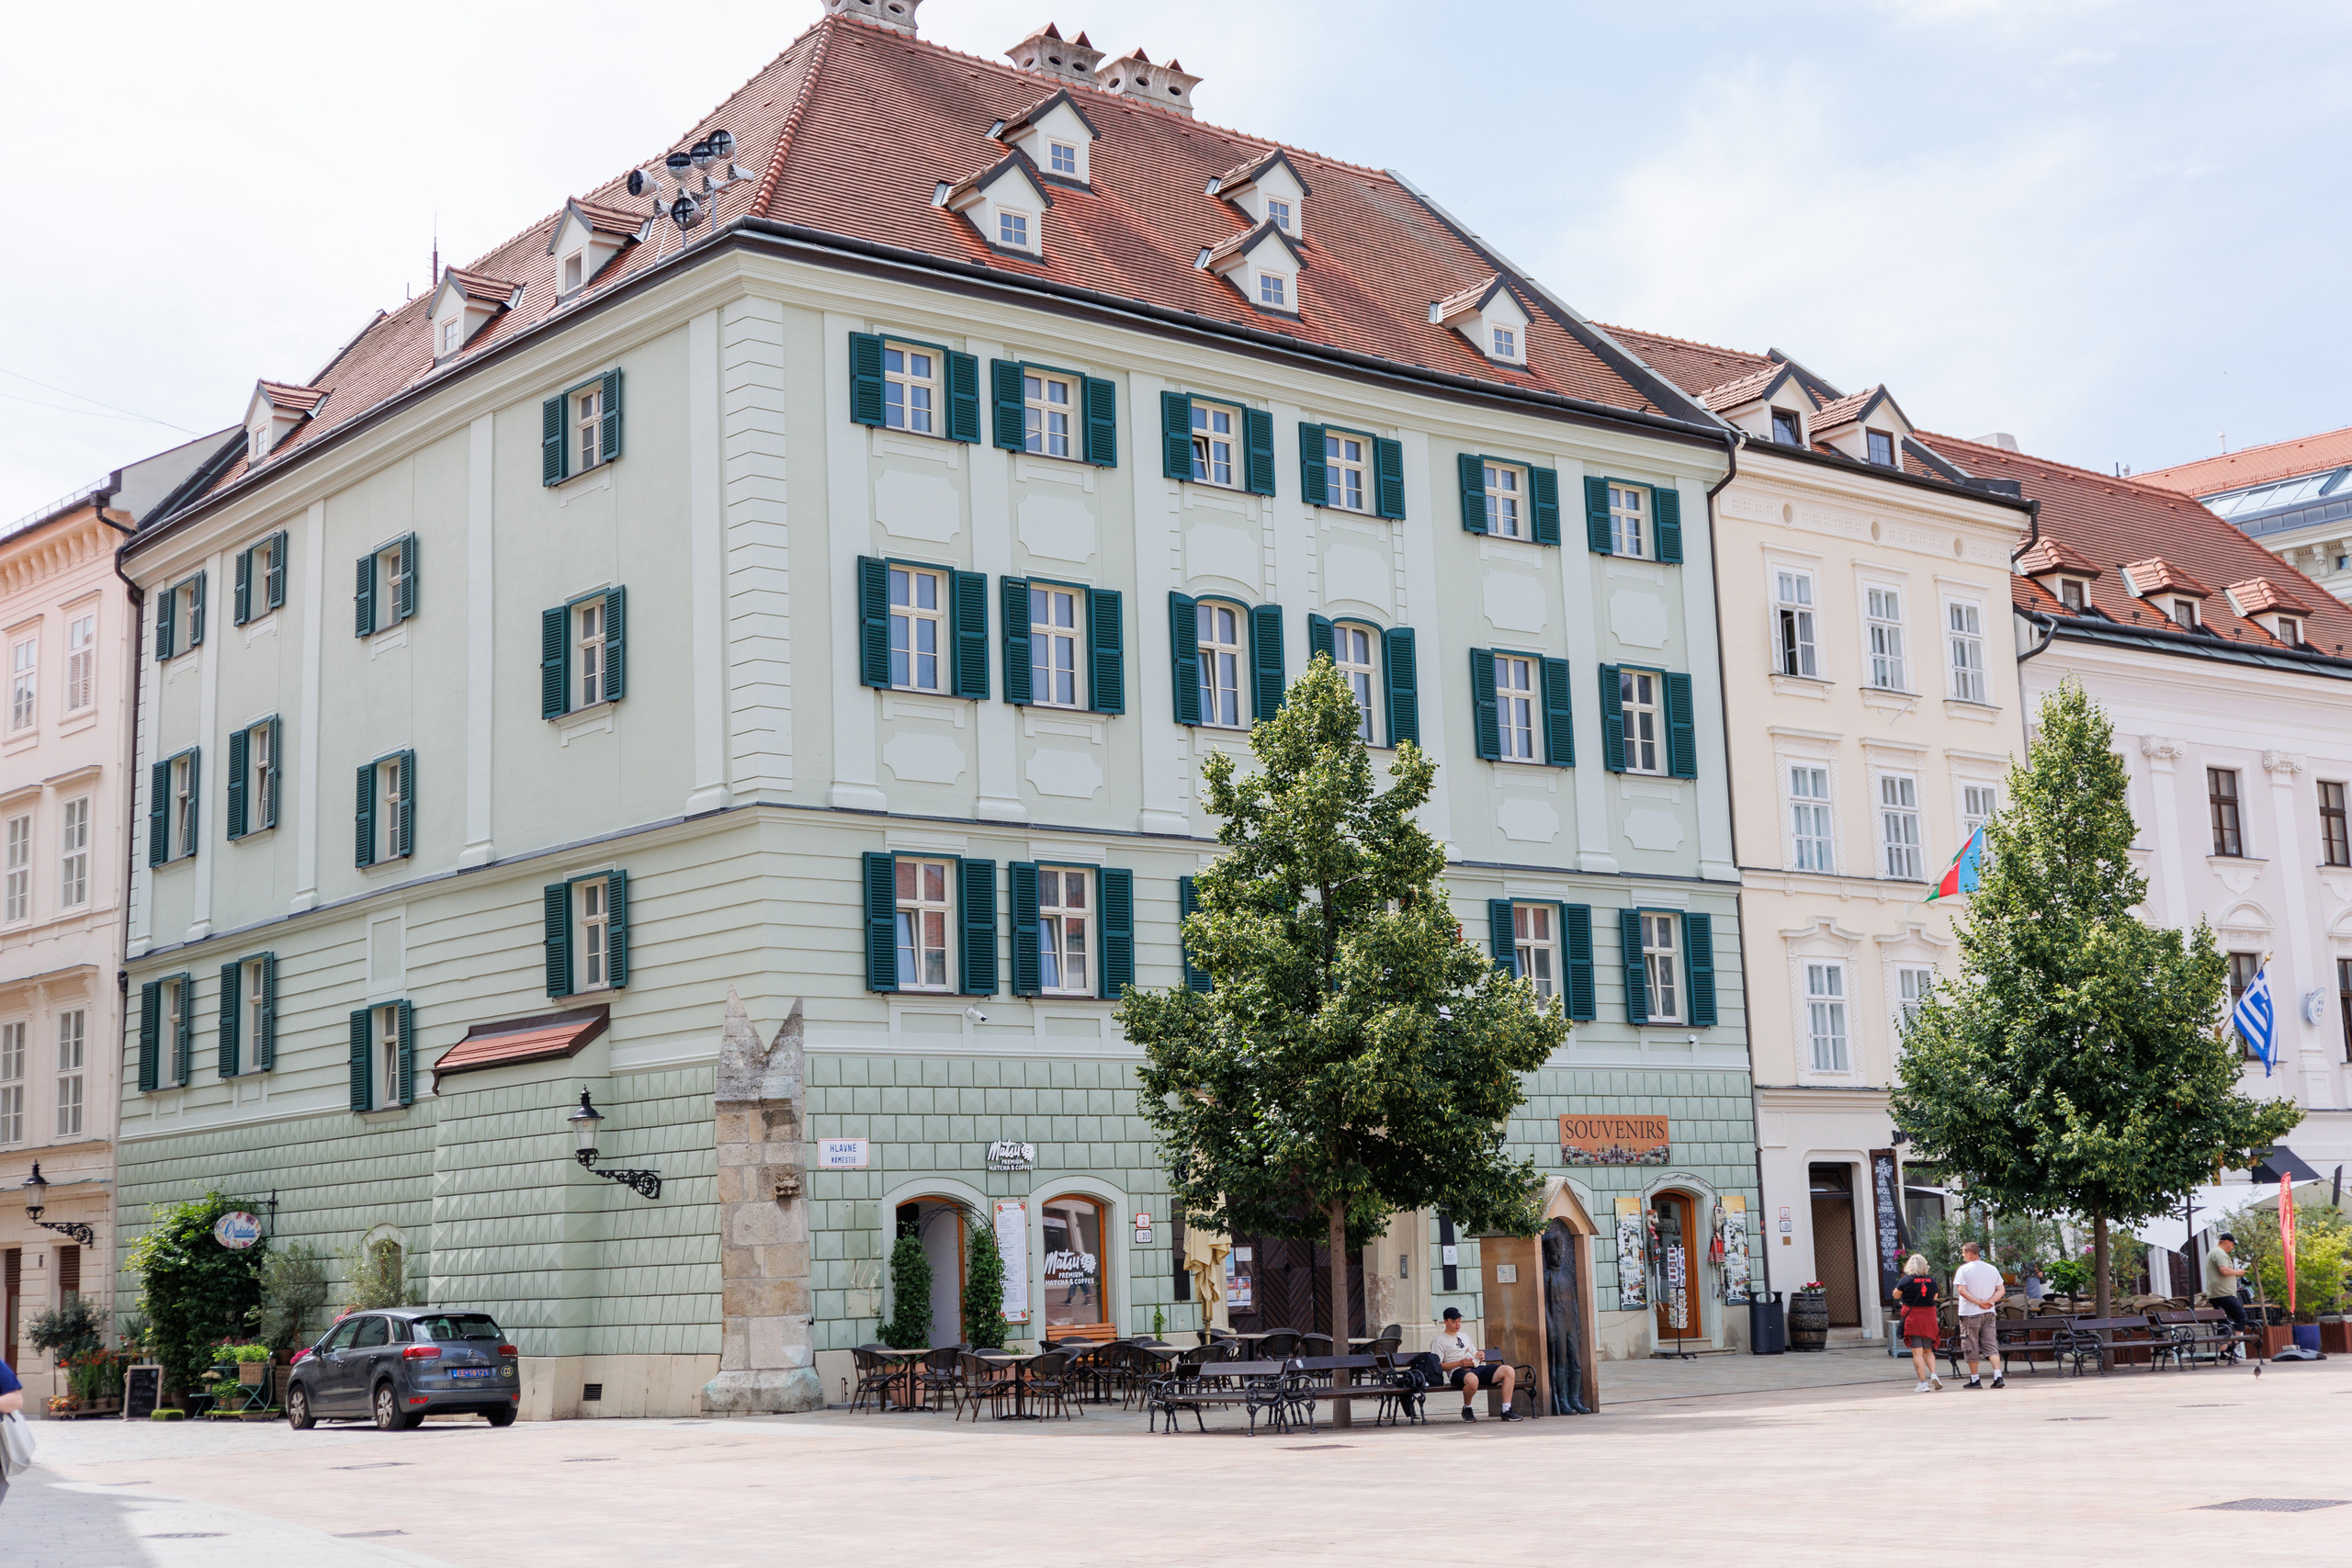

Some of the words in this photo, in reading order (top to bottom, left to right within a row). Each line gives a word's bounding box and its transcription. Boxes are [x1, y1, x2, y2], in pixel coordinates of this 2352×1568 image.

[1566, 1120, 1665, 1139] SOUVENIRS
[830, 1143, 857, 1152] HLAVNÉ
[987, 1139, 1021, 1161] Matsu
[831, 1155, 856, 1164] NÁMESTIE
[1141, 1216, 1147, 1225] 2
[1044, 1248, 1080, 1275] Matsu
[1074, 1277, 1094, 1285] COFFEE
